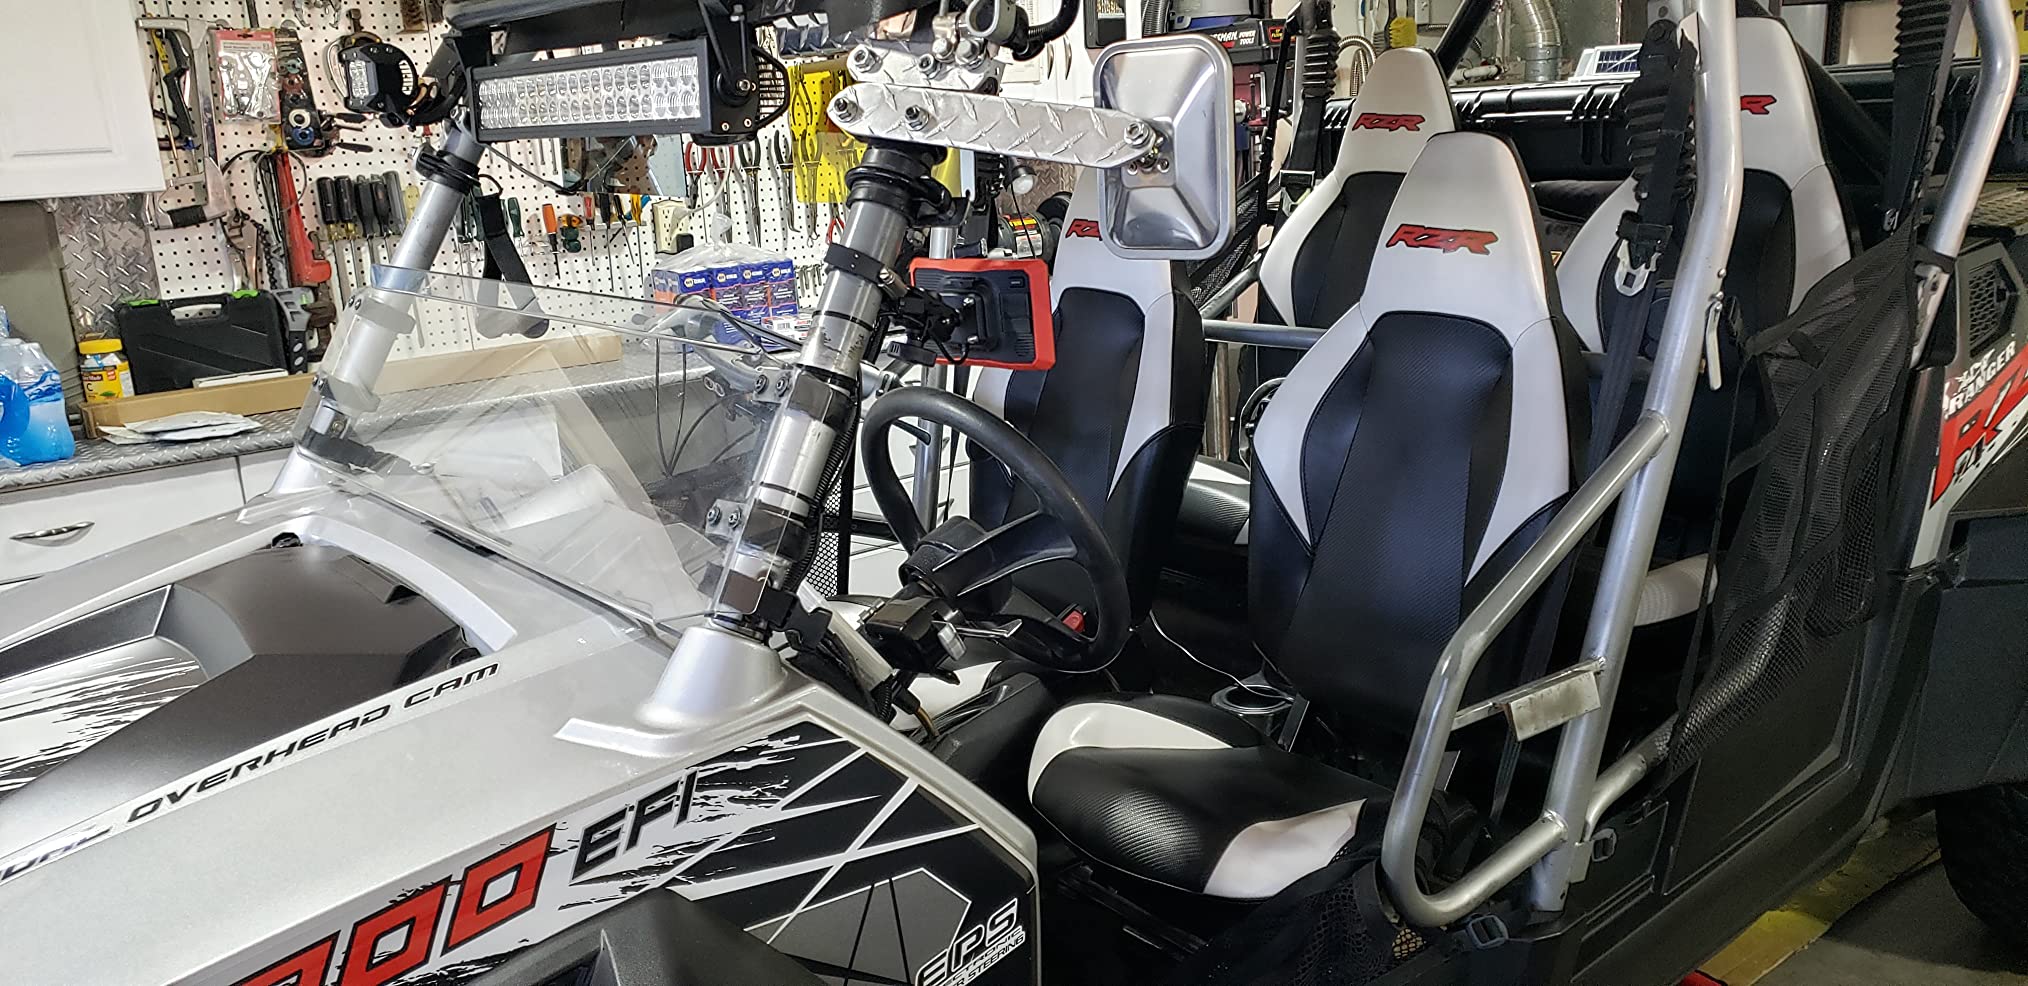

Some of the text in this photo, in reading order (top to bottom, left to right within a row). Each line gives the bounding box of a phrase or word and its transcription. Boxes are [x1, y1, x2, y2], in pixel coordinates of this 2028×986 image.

[1238, 30, 1256, 38] POWER
[1240, 37, 1255, 45] TOOLS
[1352, 112, 1426, 132] RZR
[1065, 218, 1103, 241] RZ
[1386, 223, 1499, 255] RZR
[1945, 341, 2016, 419] RANGER
[128, 704, 391, 823] OVERHEAD
[403, 663, 499, 708] CAM
[571, 770, 698, 881] EFI
[916, 898, 1018, 986] EPS
[946, 926, 1022, 983] CTRONIC
[968, 933, 1024, 980] STEERING
